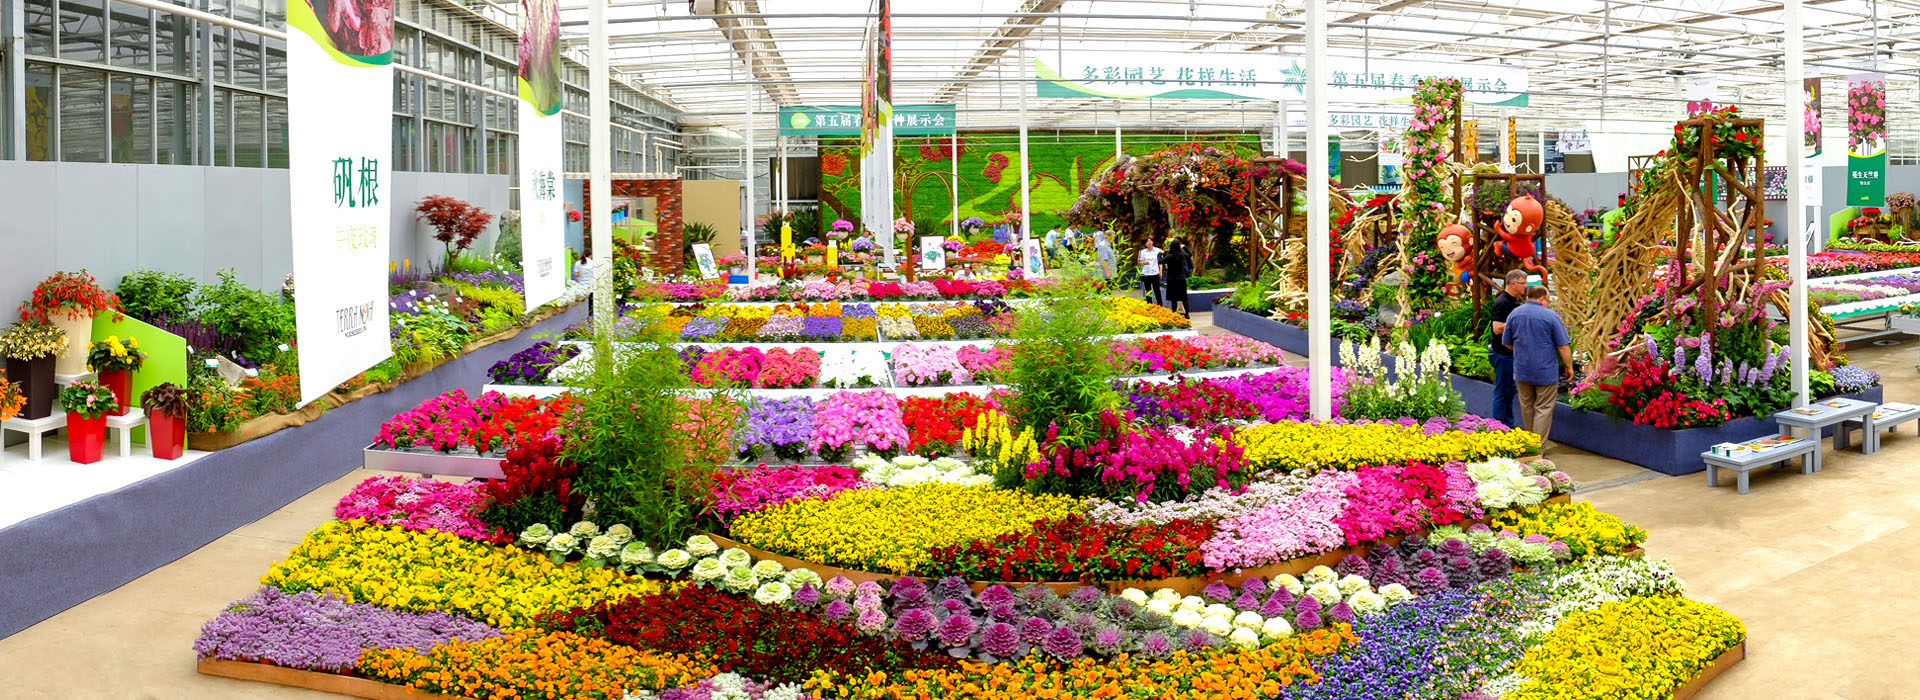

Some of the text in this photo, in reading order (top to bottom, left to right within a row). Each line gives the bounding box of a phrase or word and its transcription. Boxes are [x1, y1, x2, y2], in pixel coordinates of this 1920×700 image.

[1081, 65, 1257, 88] 多彩园艺 花样生活
[1332, 70, 1508, 94] 第五届春季展示会
[814, 113, 945, 127] 第五届春种展示会
[1329, 114, 1373, 126] 多彩园艺
[332, 156, 379, 208] 矾根
